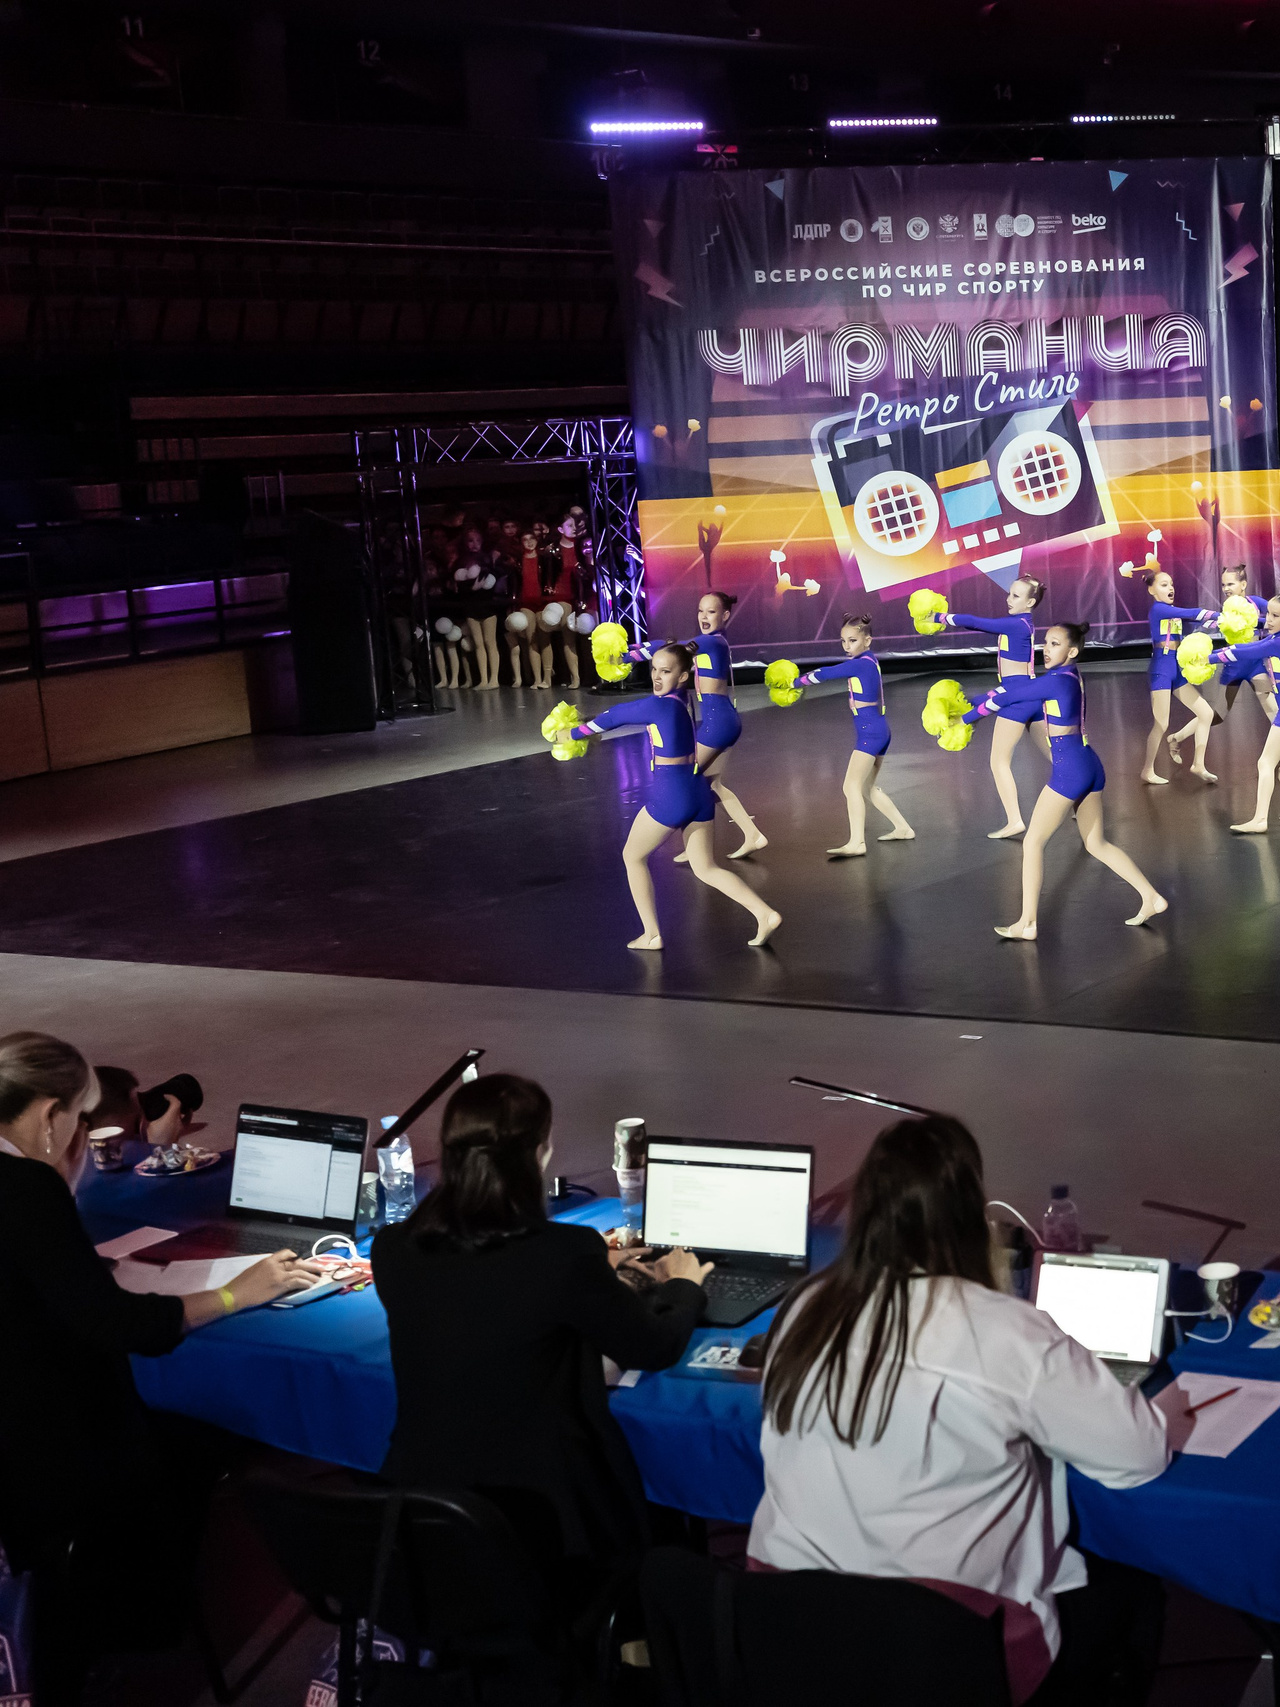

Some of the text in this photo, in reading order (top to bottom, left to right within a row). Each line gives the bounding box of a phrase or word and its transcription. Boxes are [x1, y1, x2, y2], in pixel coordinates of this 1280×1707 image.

[1071, 213, 1107, 227] beko
[792, 223, 831, 241] ЛДПР
[755, 257, 1146, 284] ВСЕРОССИЙСКИЕ СОРЕВНОВАНИЯ
[861, 277, 1045, 299] ПО ЧИР СПОРТУ
[853, 371, 1080, 435] Ретро Стиль
